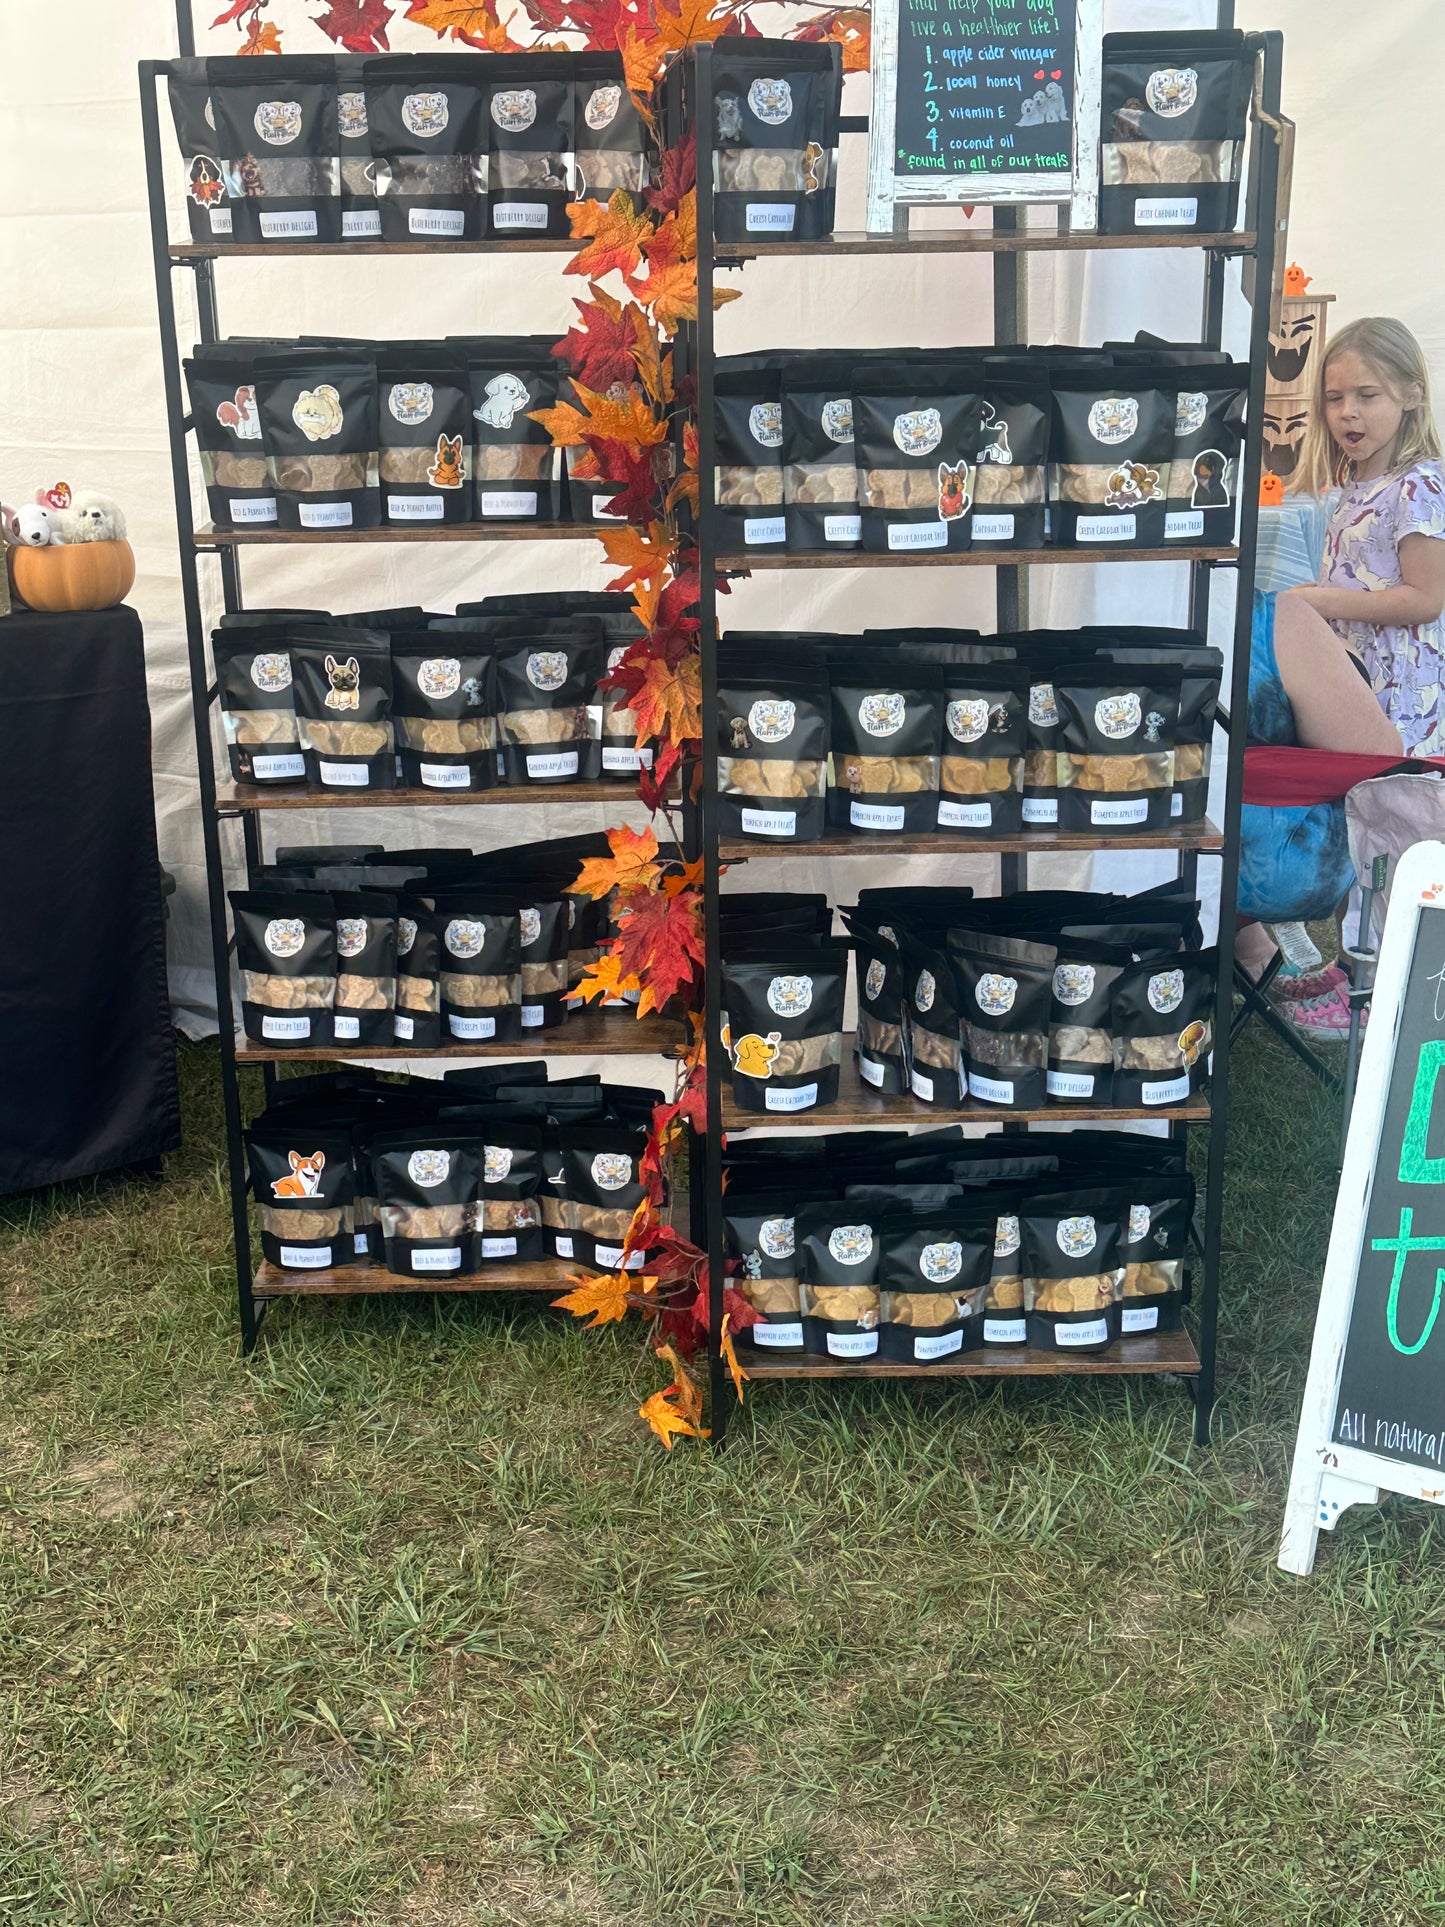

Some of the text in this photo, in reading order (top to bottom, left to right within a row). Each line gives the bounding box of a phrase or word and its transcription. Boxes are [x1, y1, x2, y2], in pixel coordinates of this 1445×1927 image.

[910, 20, 937, 37] live
[943, 21, 953, 36] a
[958, 17, 1023, 36] healthier
[943, 45, 973, 67] apple
[978, 45, 1005, 60] cider
[1011, 47, 1057, 65] vinegar
[923, 71, 1022, 92] 2. local honey
[925, 100, 1006, 122] 3. vitamin E
[925, 127, 1014, 151] 4. coconut oil
[953, 156, 966, 169] in
[970, 155, 986, 169] all
[991, 155, 1004, 168] of
[1009, 156, 1032, 168] our
[1034, 152, 1069, 168] treats
[1339, 1408, 1445, 1465] All natural
